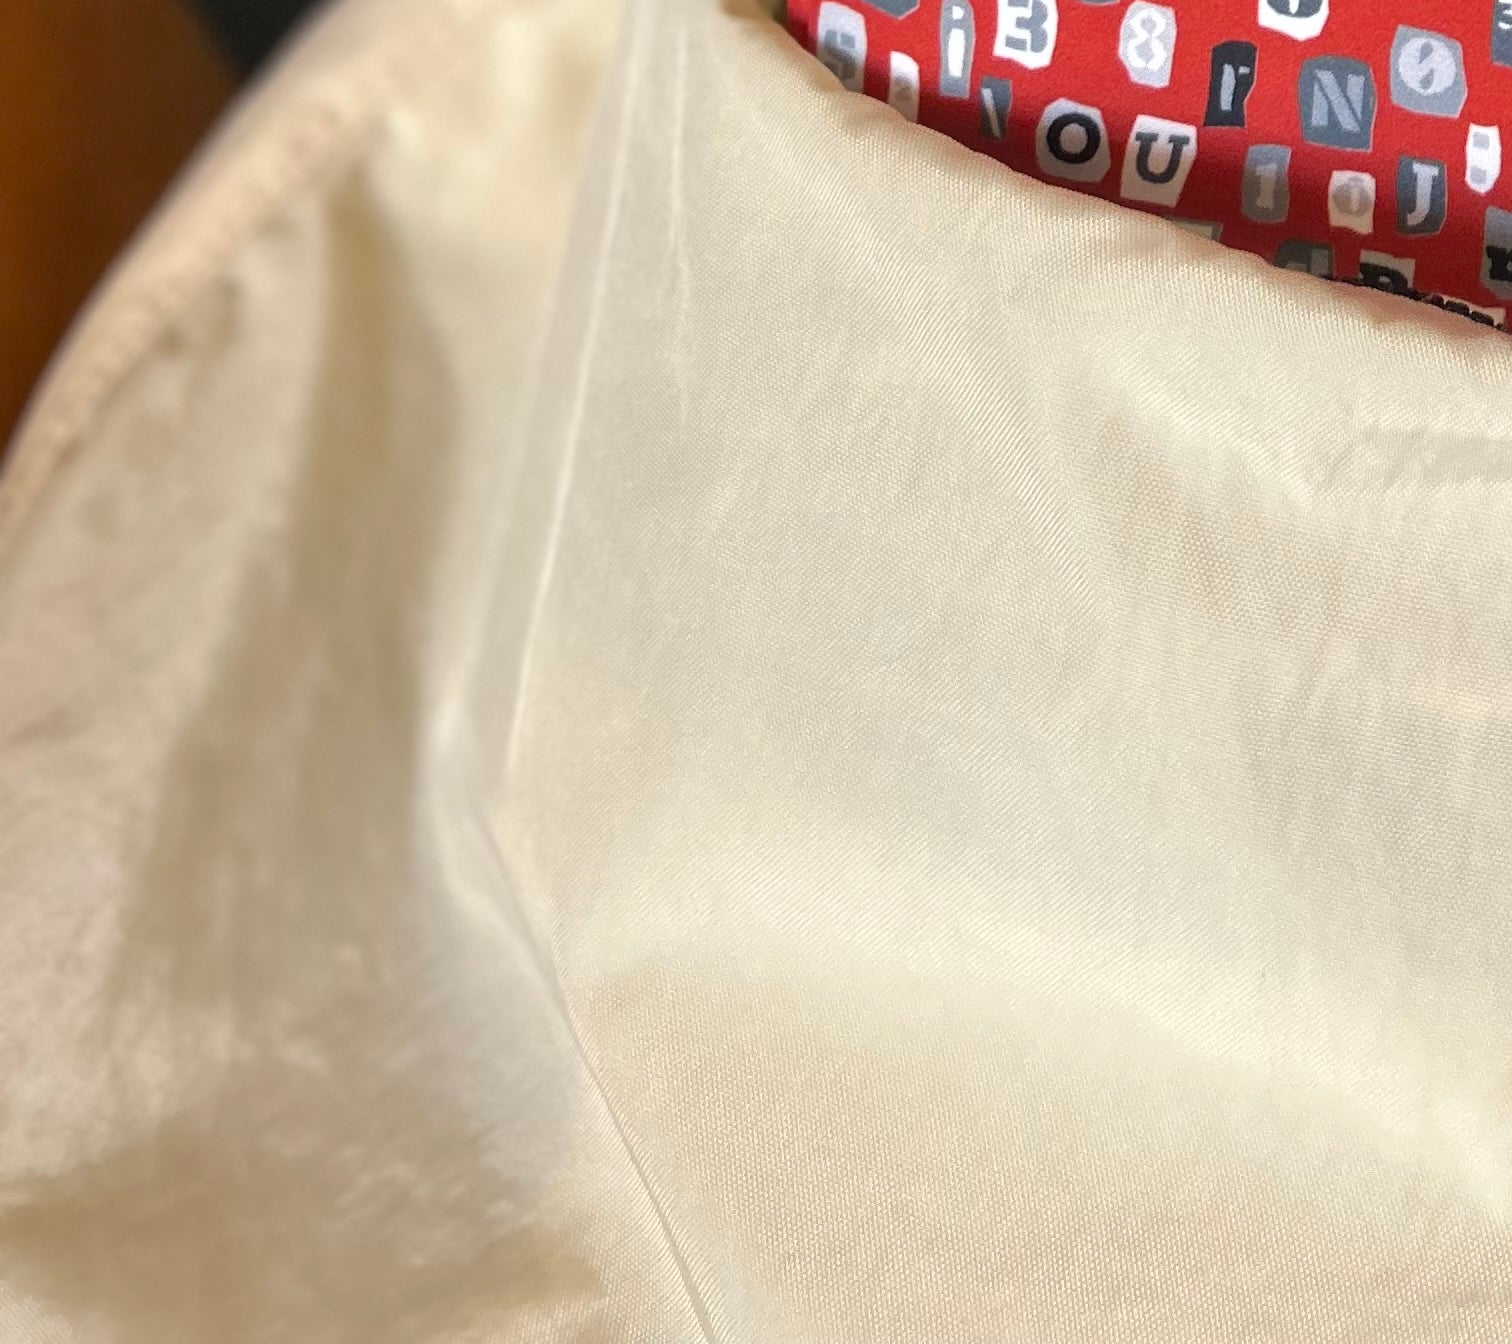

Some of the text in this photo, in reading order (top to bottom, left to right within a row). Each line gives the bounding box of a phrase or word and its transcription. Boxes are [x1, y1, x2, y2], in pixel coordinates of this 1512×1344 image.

[948, 6, 965, 77] i
[1127, 8, 1166, 71] 8
[1220, 64, 1249, 110] r
[1311, 70, 1365, 131] N
[1411, 163, 1439, 226] J
